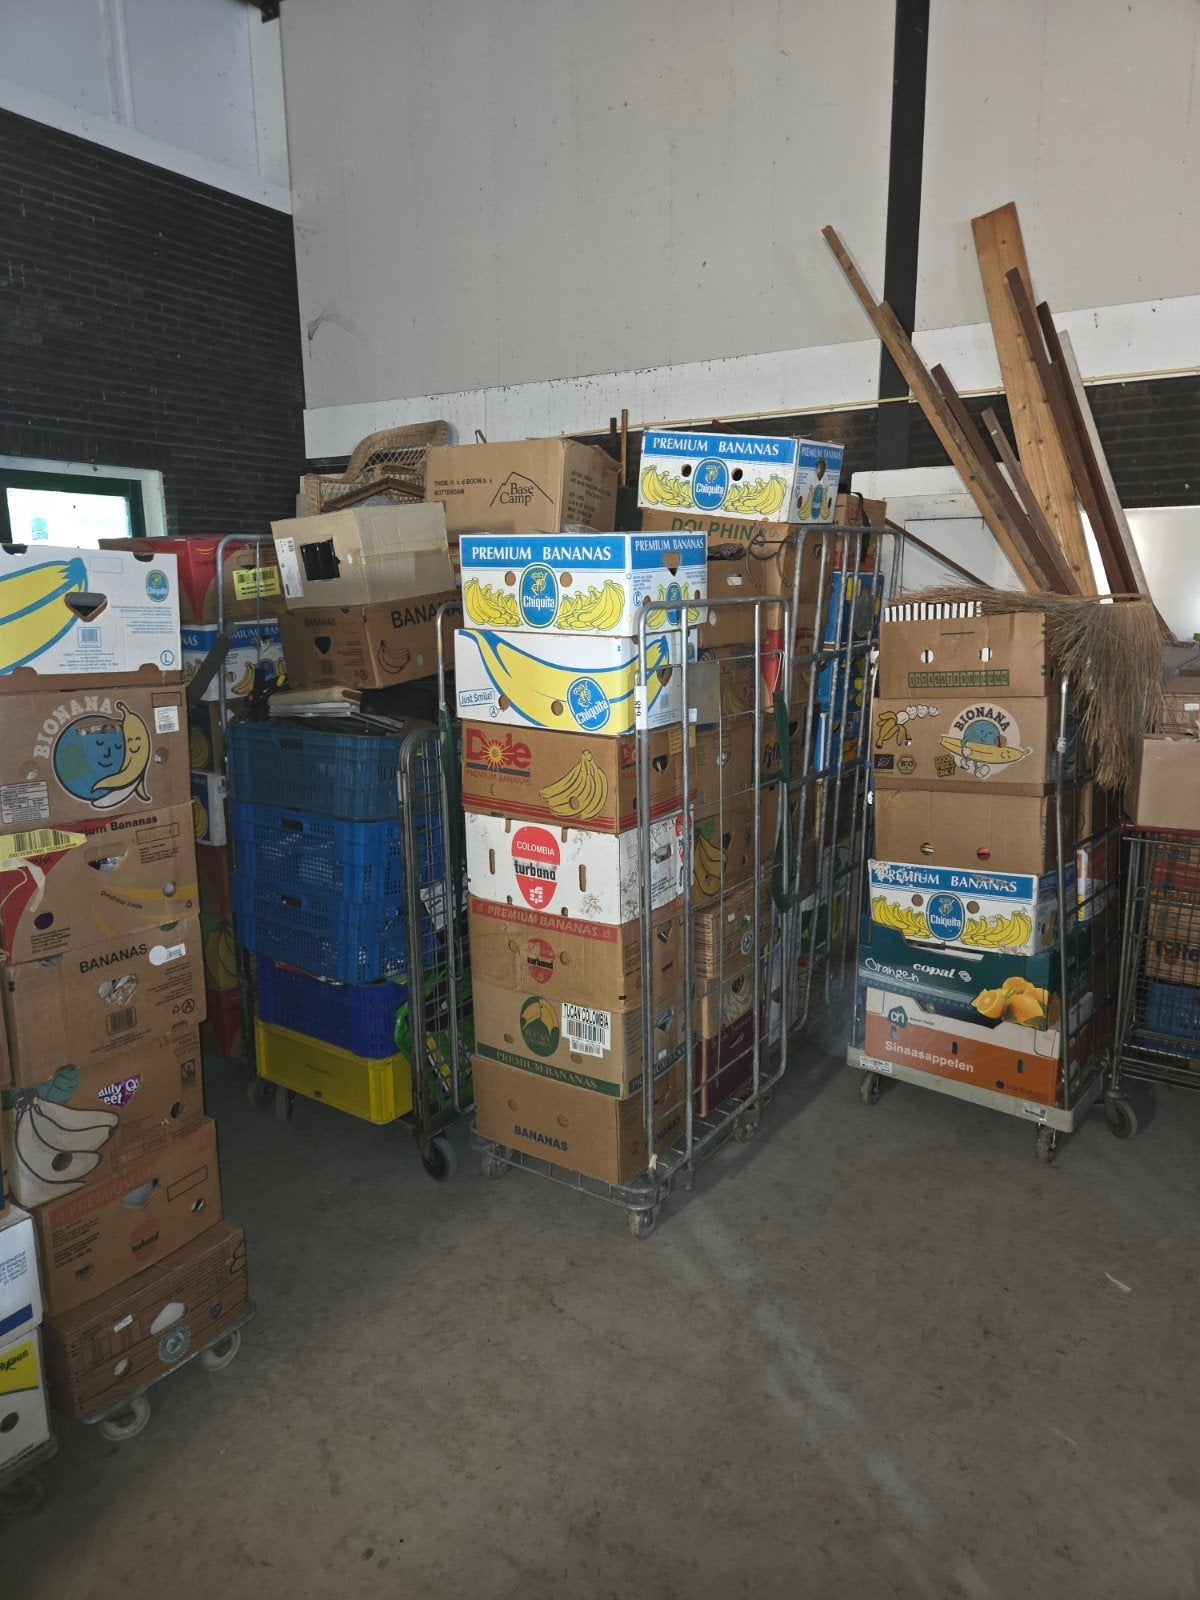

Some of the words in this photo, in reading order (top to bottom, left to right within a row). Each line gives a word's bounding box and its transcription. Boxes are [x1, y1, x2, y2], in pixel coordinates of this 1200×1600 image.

[653, 437, 708, 452] PREMIUM
[718, 441, 779, 456] BANANAS
[801, 446, 822, 458] PREMIUM
[823, 449, 842, 460] BANANAS
[510, 482, 534, 495] Base
[696, 482, 724, 496] Chiquita
[500, 492, 532, 506] Camp
[472, 546, 532, 561] PREMIUM
[543, 546, 611, 561] BANANAS
[635, 539, 670, 552] PREMIUM
[673, 538, 704, 550] BANANAS
[523, 594, 555, 610] Chiquita
[304, 617, 337, 627] BANANAS
[461, 694, 473, 705] Just
[474, 690, 493, 702] Smile!
[575, 699, 609, 725] Chiquita
[953, 706, 1011, 732] BIONANA
[33, 696, 113, 759] BIONANA
[466, 728, 531, 769] Dole
[466, 769, 497, 780] PREMIUM
[499, 774, 531, 786] BANANAS
[110, 815, 158, 831] Bananas
[516, 841, 556, 856] COLOMBIA
[514, 859, 556, 881] turbana
[881, 869, 940, 885] PREMIUM
[951, 875, 1018, 893] BANANAS
[100, 890, 126, 906] goodness
[487, 906, 538, 924] PREMIUM
[540, 916, 598, 937] BANANAS
[930, 914, 961, 928] Chiquita
[79, 943, 148, 974] BANANAS
[865, 957, 920, 983] Orangen
[912, 963, 956, 979] copal
[564, 1003, 581, 1020] TUCAN
[884, 1040, 974, 1073] Sinaasappelen
[496, 1051, 542, 1075] PREMIUM
[543, 1066, 598, 1090] BANANAS
[514, 1124, 569, 1151] BANANAS
